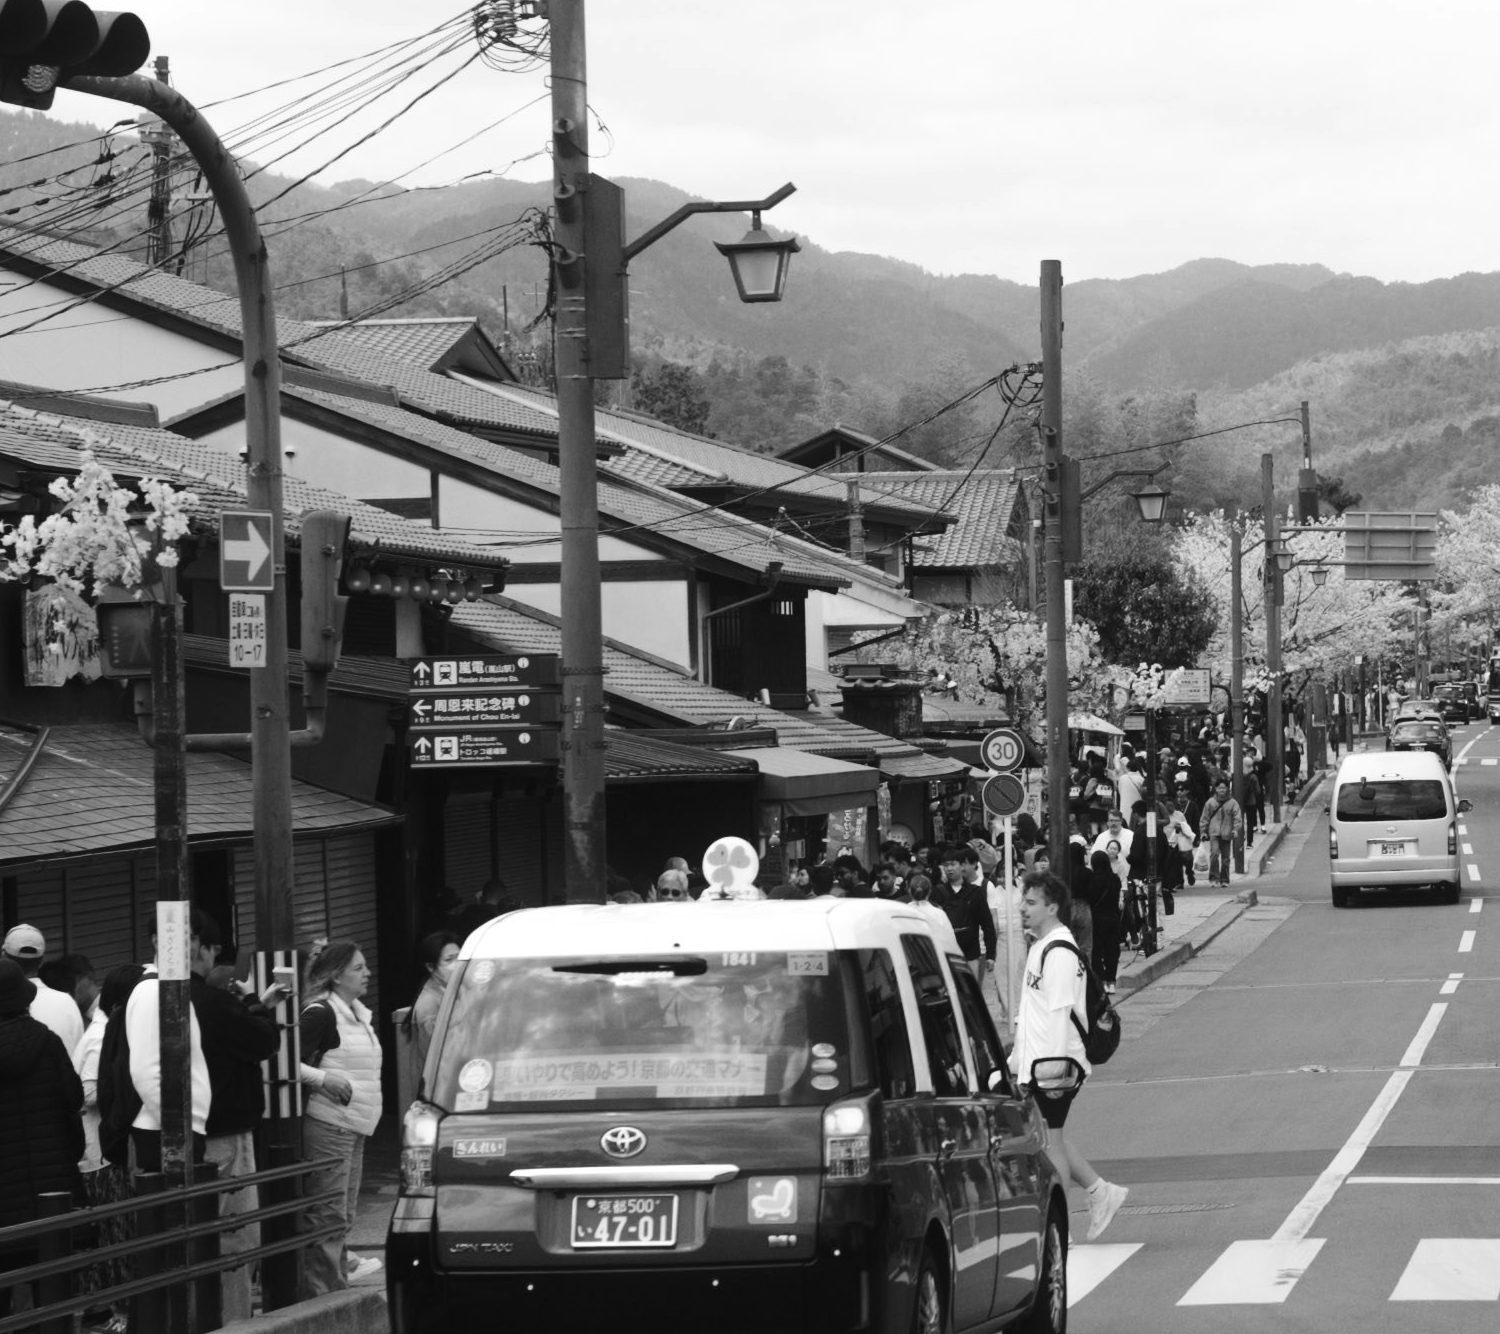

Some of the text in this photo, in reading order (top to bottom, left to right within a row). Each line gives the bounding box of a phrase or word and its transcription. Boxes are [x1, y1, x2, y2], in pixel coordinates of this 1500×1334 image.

[433, 697, 516, 713] 周恩来記念碑
[992, 742, 1014, 760] 30
[722, 953, 757, 967] 1841
[594, 1215, 667, 1242] 47-01
